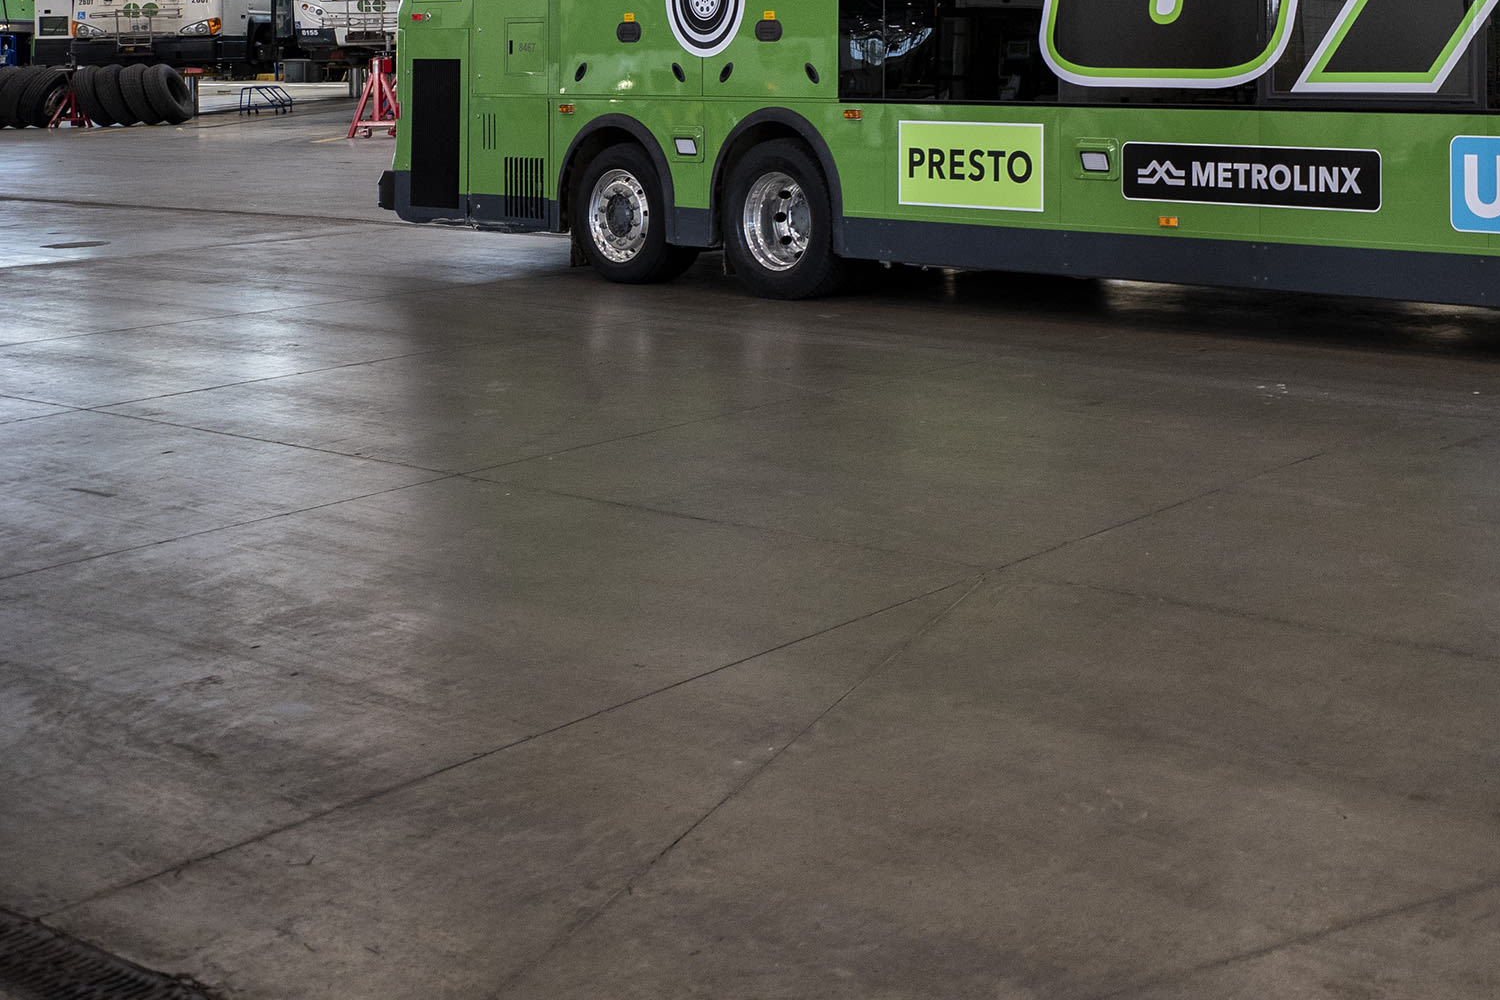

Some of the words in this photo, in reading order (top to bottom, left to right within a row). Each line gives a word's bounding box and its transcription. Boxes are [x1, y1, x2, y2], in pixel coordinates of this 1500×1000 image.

[518, 42, 537, 53] 8467
[907, 147, 1034, 184] PRESTO
[1191, 160, 1363, 195] METROLINX
